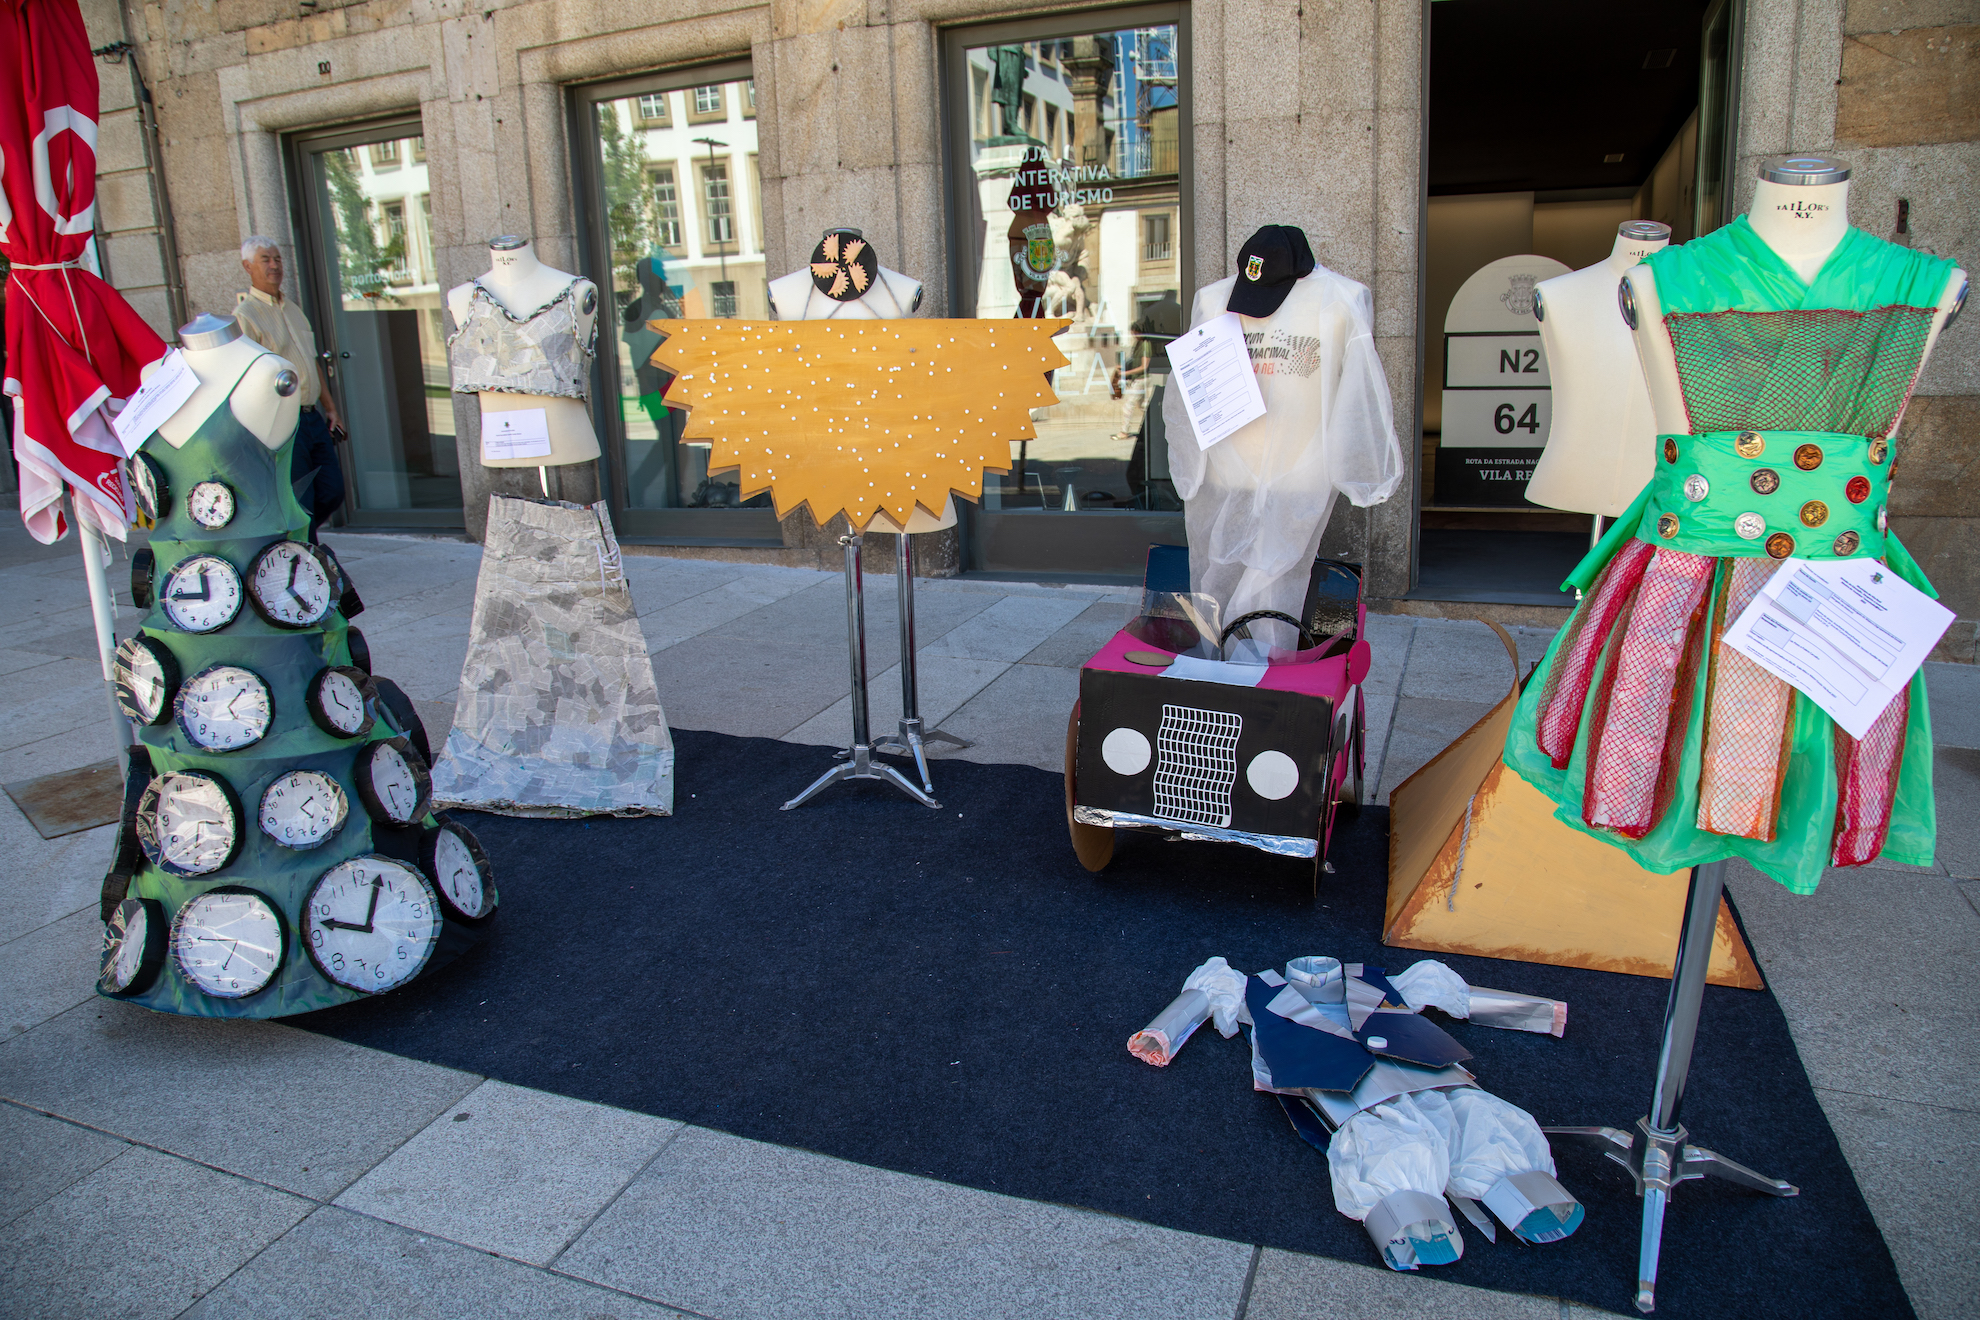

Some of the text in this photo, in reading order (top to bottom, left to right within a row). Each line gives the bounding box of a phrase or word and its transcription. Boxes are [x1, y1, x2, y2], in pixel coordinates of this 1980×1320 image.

[1009, 146, 1051, 164] LOJA
[1010, 164, 1110, 188] INTERATIVA
[1010, 187, 1113, 211] DE TURISMO
[1776, 201, 1829, 211] TAILOR'S
[1500, 350, 1539, 373] N2
[1053, 350, 1146, 396] EAL
[1494, 403, 1540, 434] 64
[1480, 470, 1533, 480] VILA RE
[278, 549, 290, 558] 12
[266, 558, 275, 568] 11
[306, 562, 312, 571] 2
[316, 574, 324, 586] 3
[228, 587, 234, 597] 3
[314, 595, 322, 604] 4
[281, 609, 290, 618] 7
[297, 610, 304, 620] 6
[203, 618, 210, 626] 6
[226, 676, 236, 684] 12
[212, 682, 220, 691] 11
[254, 688, 260, 699] 2
[191, 707, 198, 718] 9
[256, 719, 263, 728] 4
[200, 724, 208, 735] 8
[244, 728, 252, 738] 5
[210, 732, 218, 742] 7
[290, 778, 301, 788] 12
[315, 782, 323, 792] 2
[276, 788, 284, 798] 11
[322, 792, 332, 802] 3
[268, 802, 278, 810] 10
[324, 806, 332, 814] 4
[268, 816, 278, 826] 9
[322, 815, 330, 825] 5
[285, 826, 294, 838] 8
[298, 828, 307, 836] 7
[310, 826, 318, 836] 6
[352, 870, 369, 888] 12
[388, 880, 392, 892] 1
[332, 885, 345, 899] 11
[400, 890, 408, 904] 2
[221, 894, 232, 903] 12
[205, 904, 212, 912] 11
[315, 904, 331, 920] 10
[410, 902, 423, 919] 3
[196, 919, 205, 928] 10
[274, 929, 281, 938] 3
[408, 930, 417, 942] 4
[186, 938, 194, 950] 9
[311, 930, 324, 948] 9
[266, 952, 274, 962] 4
[397, 946, 408, 960] 5
[195, 960, 202, 968] 8
[331, 952, 346, 970] 8
[354, 958, 367, 970] 7
[252, 968, 258, 976] 5
[374, 964, 384, 979] 6
[212, 974, 222, 984] 7
[230, 978, 238, 988] 6
